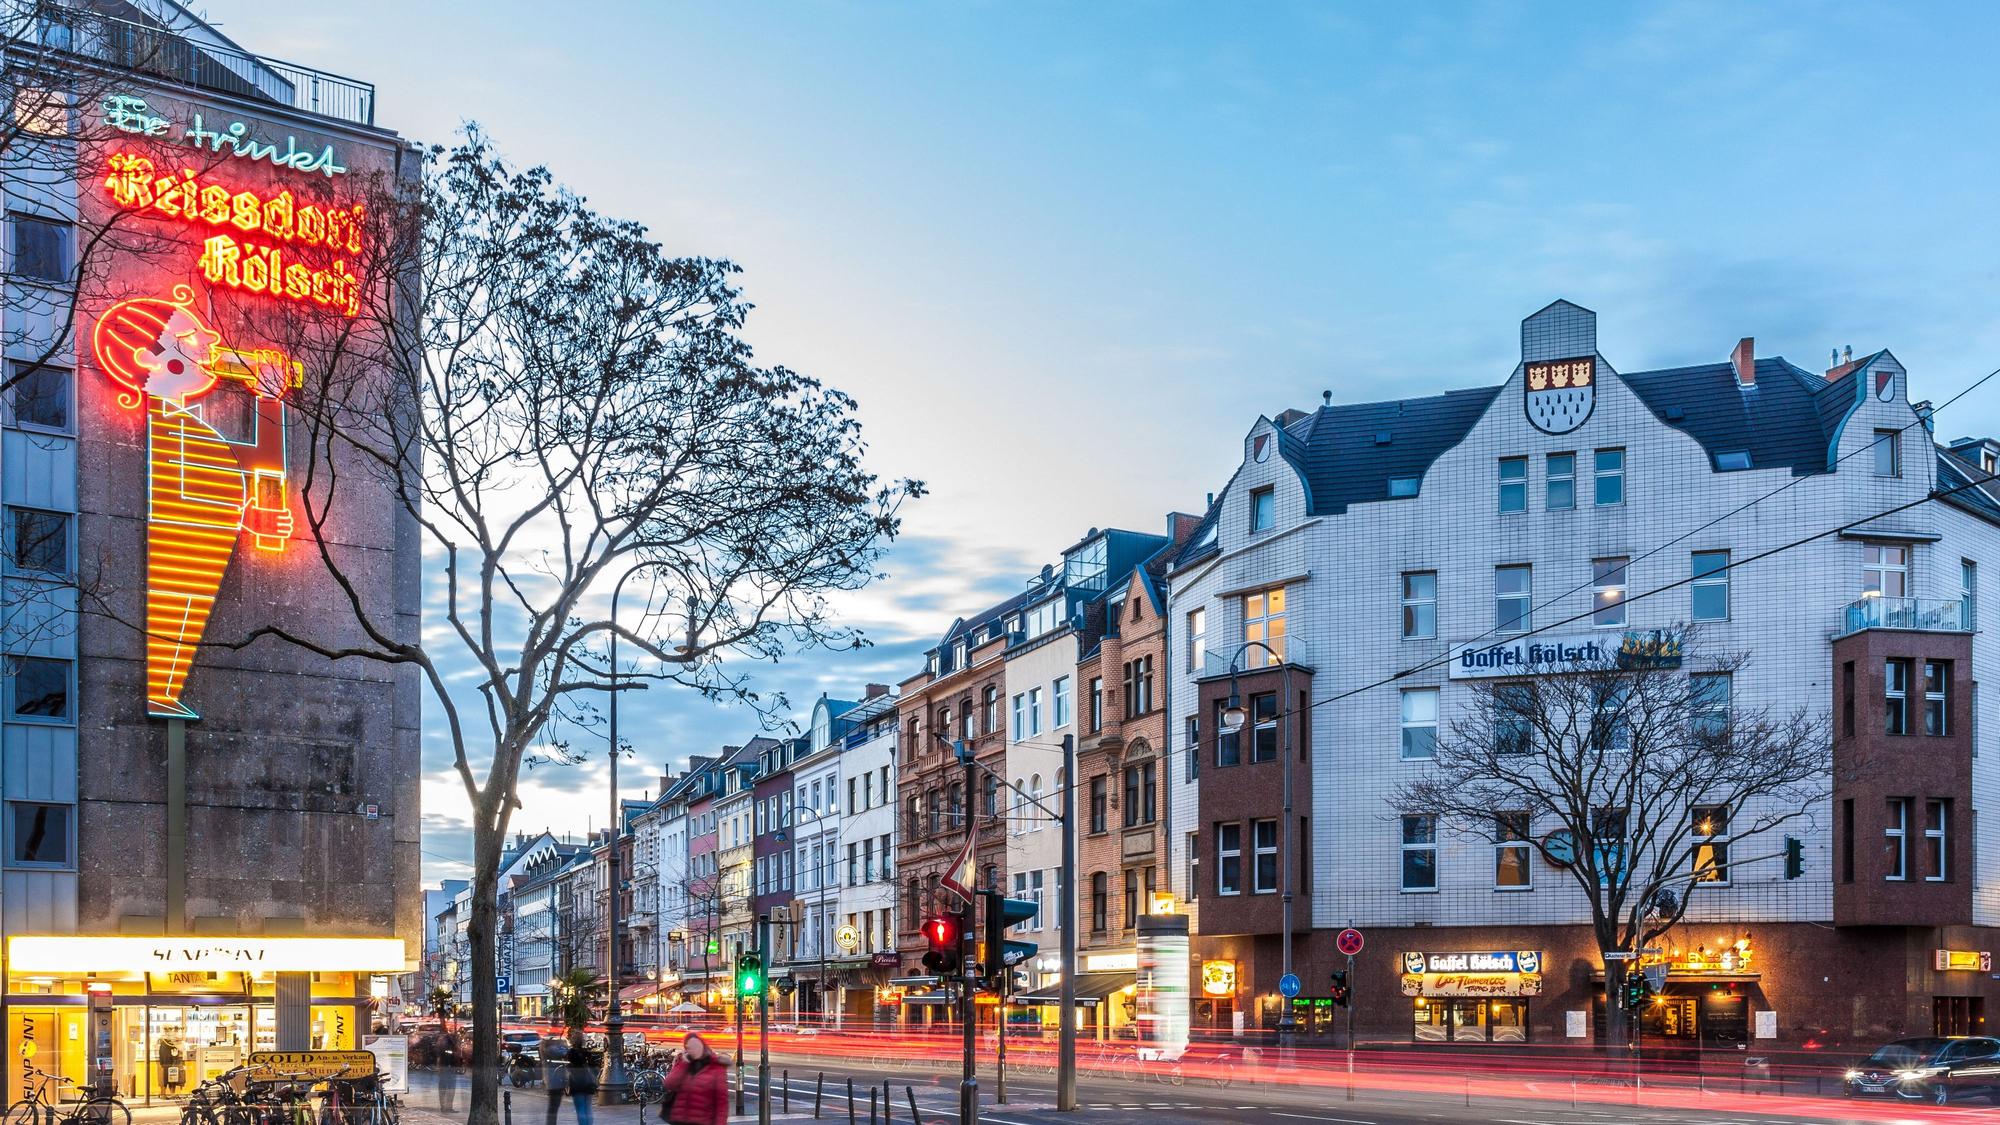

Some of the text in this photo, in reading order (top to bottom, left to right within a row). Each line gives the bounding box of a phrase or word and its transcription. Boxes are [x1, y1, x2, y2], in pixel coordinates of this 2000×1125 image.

[186, 113, 347, 178] trinkt
[104, 153, 366, 254] Reissdorf
[199, 234, 362, 317] Kölsch
[1462, 640, 1600, 668] Gaffel Kölsch
[1430, 954, 1468, 971] Gaffel
[1470, 954, 1513, 971] Kölsch
[497, 979, 506, 992] P
[252, 1054, 314, 1063] GOLD
